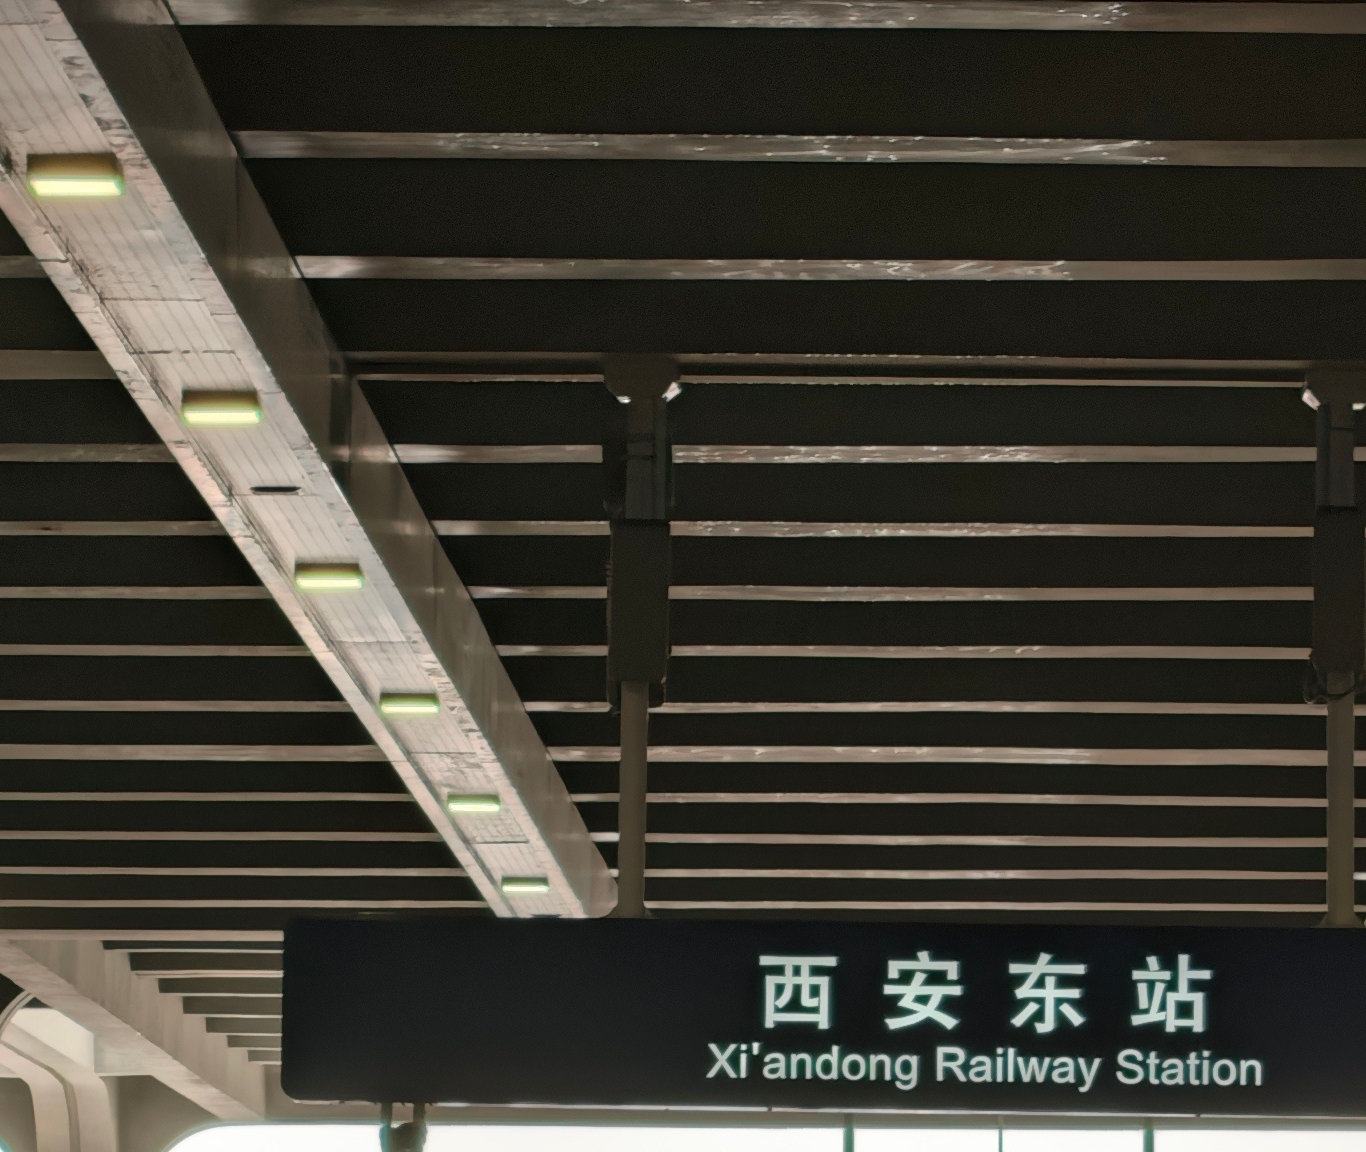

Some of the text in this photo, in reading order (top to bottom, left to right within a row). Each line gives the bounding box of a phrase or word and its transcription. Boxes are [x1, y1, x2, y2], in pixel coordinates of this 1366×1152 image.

[758, 951, 1213, 1033] 西安东站
[705, 1041, 1263, 1092] Xi'andong Railway Station
